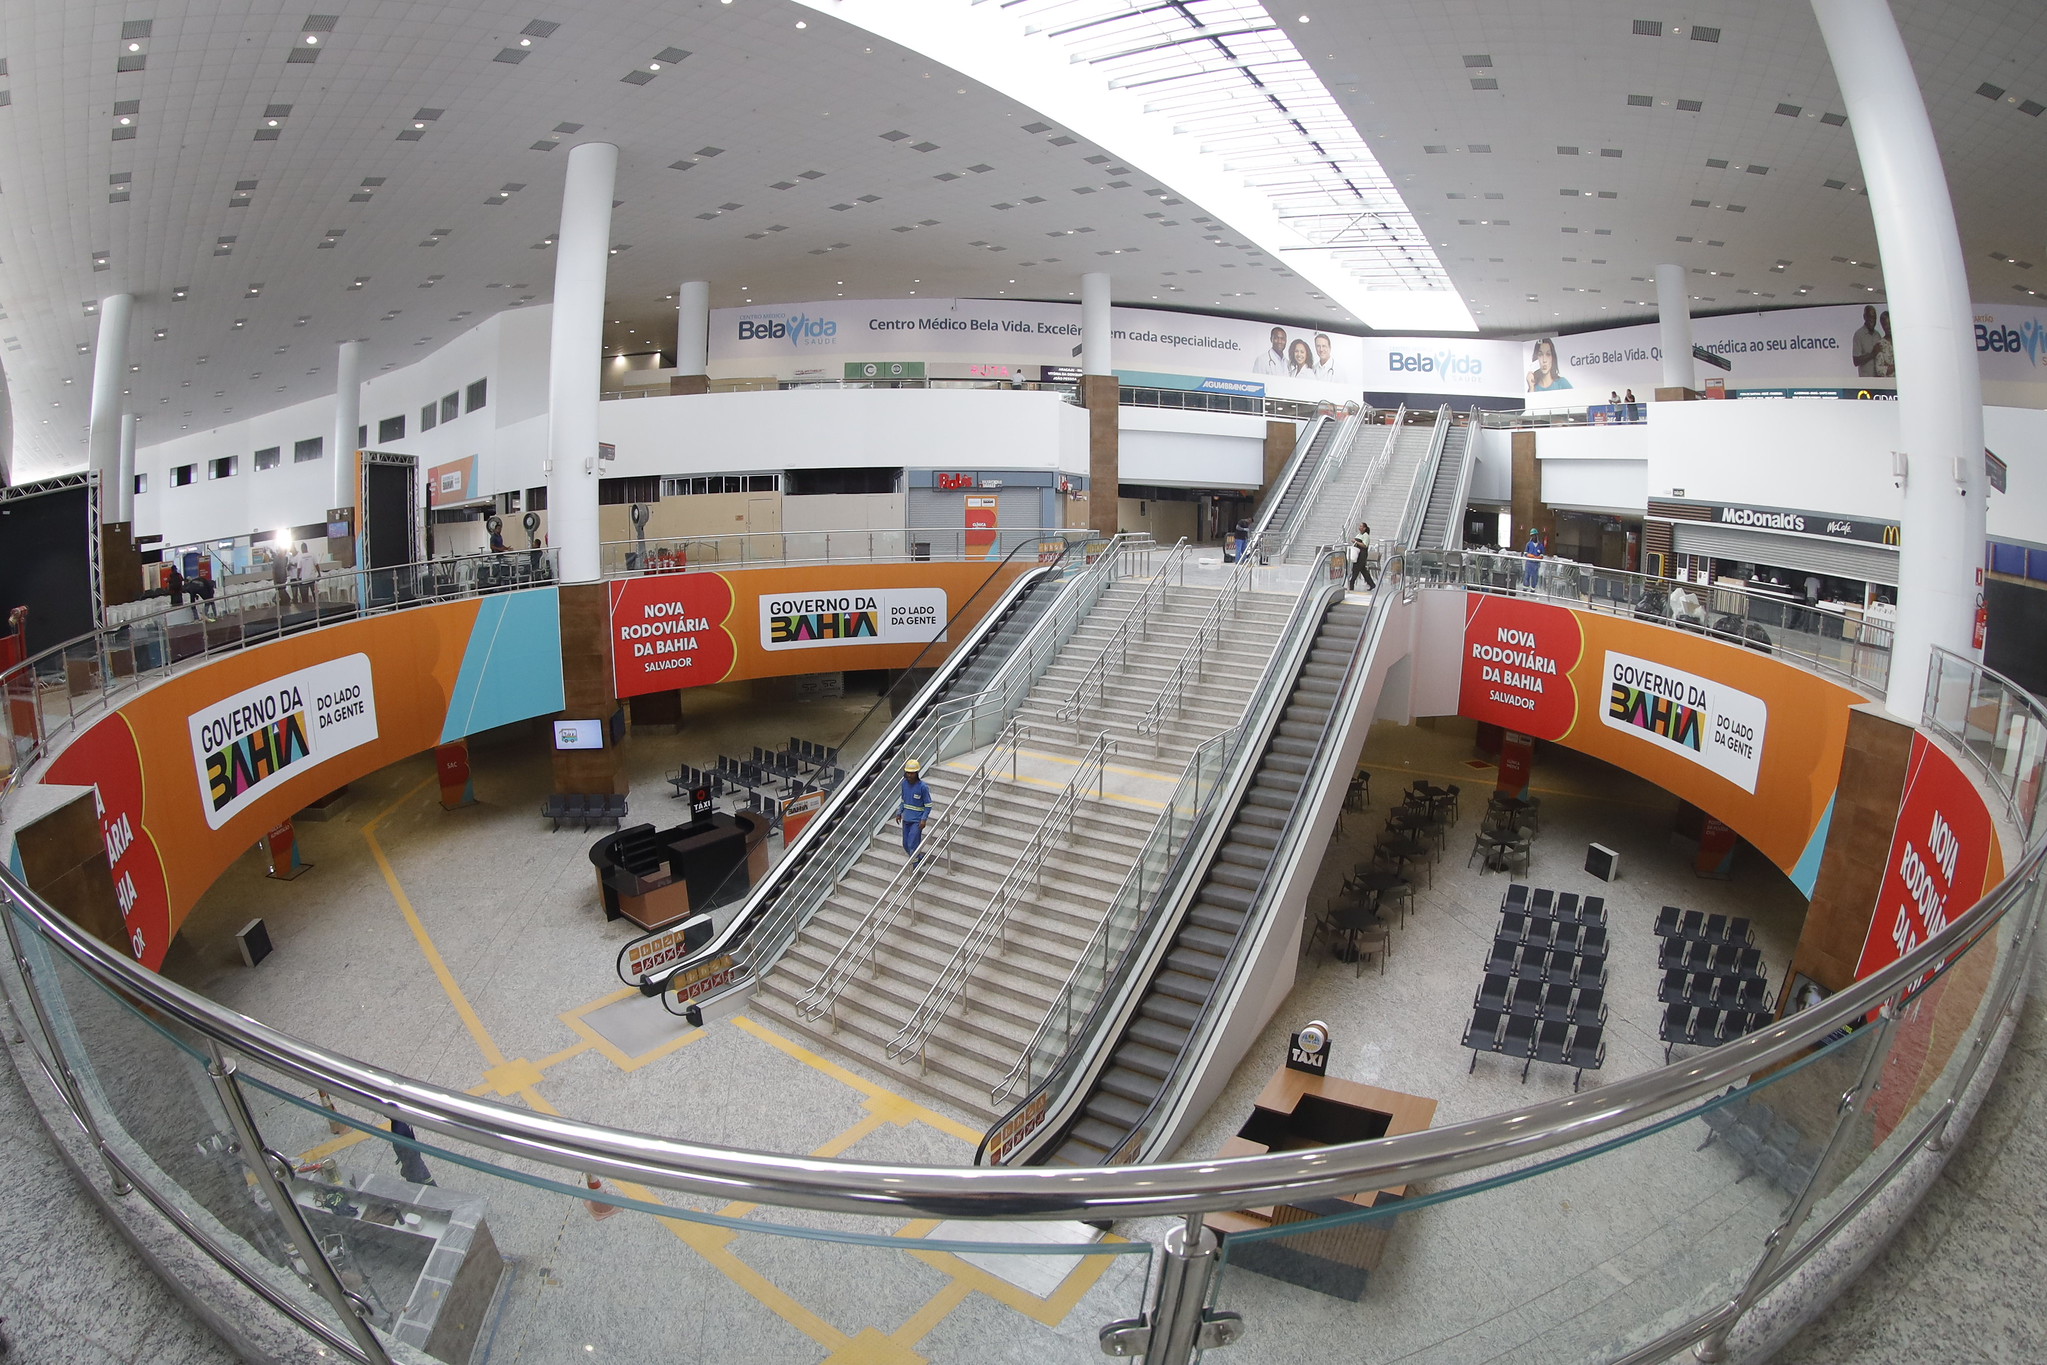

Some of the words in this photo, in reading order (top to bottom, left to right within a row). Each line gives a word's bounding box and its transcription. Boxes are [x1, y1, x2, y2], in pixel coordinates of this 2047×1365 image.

[869, 318, 915, 330] Centro
[918, 318, 967, 331] Médico
[970, 319, 998, 331] Bela
[1001, 320, 1034, 333] Vida.
[1129, 330, 1158, 342] cada
[1160, 335, 1241, 351] especialidade.
[1570, 353, 1600, 366] Cartão
[1602, 350, 1622, 363] Bela
[1624, 348, 1648, 361] Vida.
[1750, 341, 1764, 352] ao
[1766, 340, 1786, 351] seu
[1790, 335, 1839, 351] alcance.
[970, 364, 1009, 377] ROTA
[1721, 507, 1805, 531] McDonald's
[644, 601, 684, 618] NOVA
[770, 598, 850, 615] GOVERNO
[855, 597, 877, 611] DA
[891, 606, 907, 615] DO
[908, 606, 934, 615] LADO
[621, 616, 709, 640] RODOVIÁRIA
[891, 617, 905, 626] DA
[906, 616, 936, 625] GENTE
[634, 642, 653, 657] DA
[656, 636, 698, 654] BAHIA
[1497, 627, 1536, 649] NOVA
[644, 657, 692, 672] SALVADOR
[1472, 643, 1557, 676] RODOVIÁRIA
[1482, 665, 1501, 683] DA
[1503, 670, 1543, 693] BAHIA
[1613, 663, 1684, 701] GOVERNO
[1687, 685, 1707, 711] DA
[317, 694, 332, 711] DO
[334, 684, 361, 704] LADO
[1489, 689, 1535, 711] SALVADOR
[201, 695, 276, 753] GOVERNO
[280, 686, 303, 714] DA
[319, 713, 333, 729] DA
[334, 700, 364, 723] GENTE
[1717, 714, 1730, 730] DO
[1731, 720, 1753, 741] LADO
[1714, 730, 1726, 747] DA
[1727, 736, 1753, 760] GENTE
[447, 761, 458, 769] SAC
[1928, 809, 1959, 889] NOVA
[1892, 903, 1910, 958] DA
[1292, 1048, 1324, 1067] TAXI
